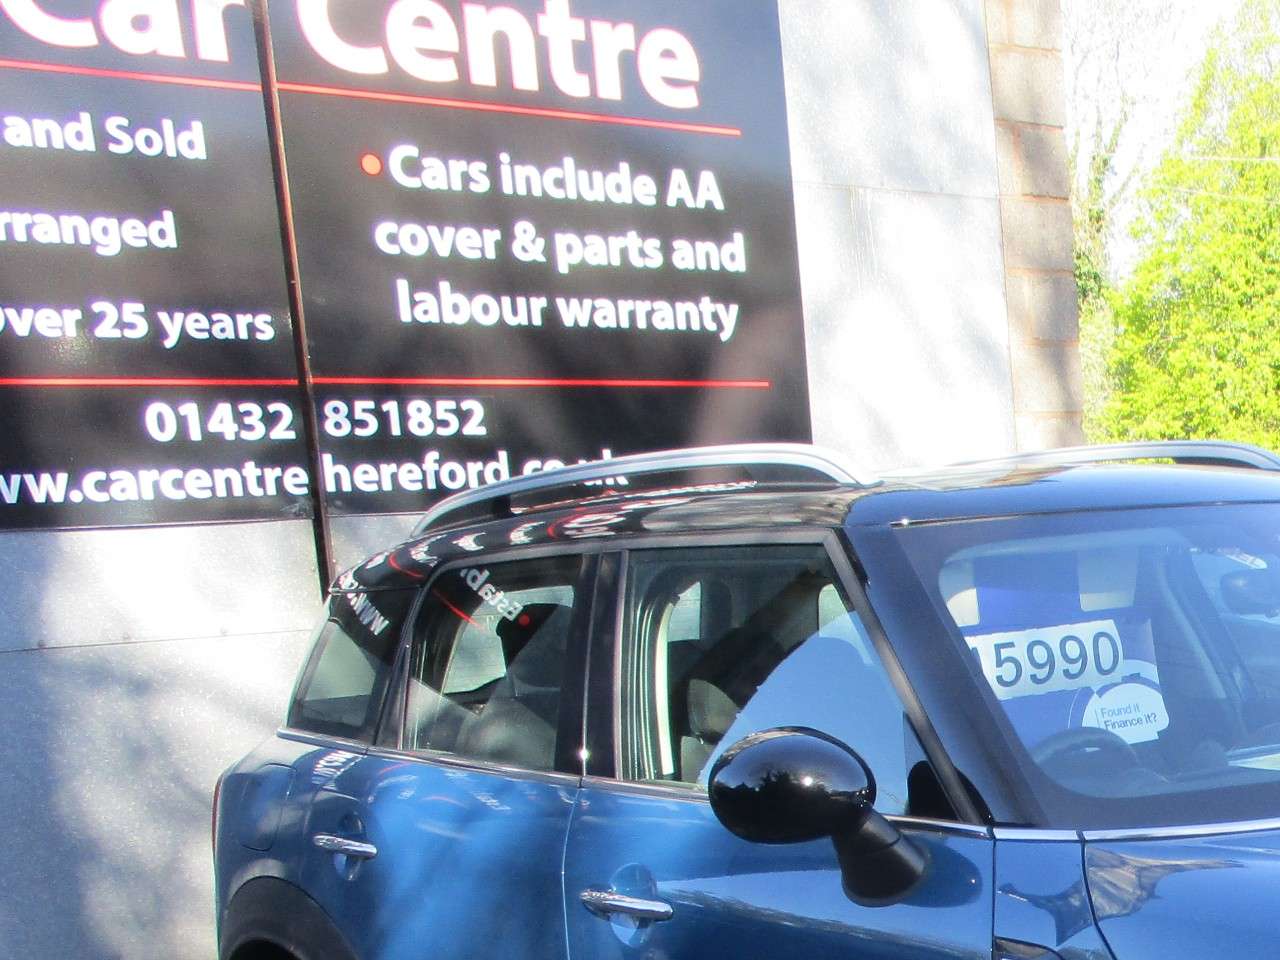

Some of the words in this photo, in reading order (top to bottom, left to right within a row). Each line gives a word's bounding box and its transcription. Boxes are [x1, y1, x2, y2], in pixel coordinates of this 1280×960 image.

[297, 0, 700, 108] Centre
[3, 112, 96, 151] and
[105, 116, 207, 160] Sold
[388, 144, 490, 193] Cars
[500, 152, 657, 206] include
[666, 168, 725, 210] AA
[374, 221, 501, 260] cover
[511, 220, 547, 262] &
[554, 230, 664, 273] parts
[672, 232, 747, 272] and
[0, 304, 82, 338] ver
[91, 301, 149, 339] 25
[156, 311, 275, 350] years
[396, 278, 547, 327] labour
[554, 296, 740, 343] warranty
[144, 401, 297, 442] 01432
[323, 399, 488, 437] 851852
[1100, 703, 1132, 719] Found
[1104, 716, 1143, 731] Finance
